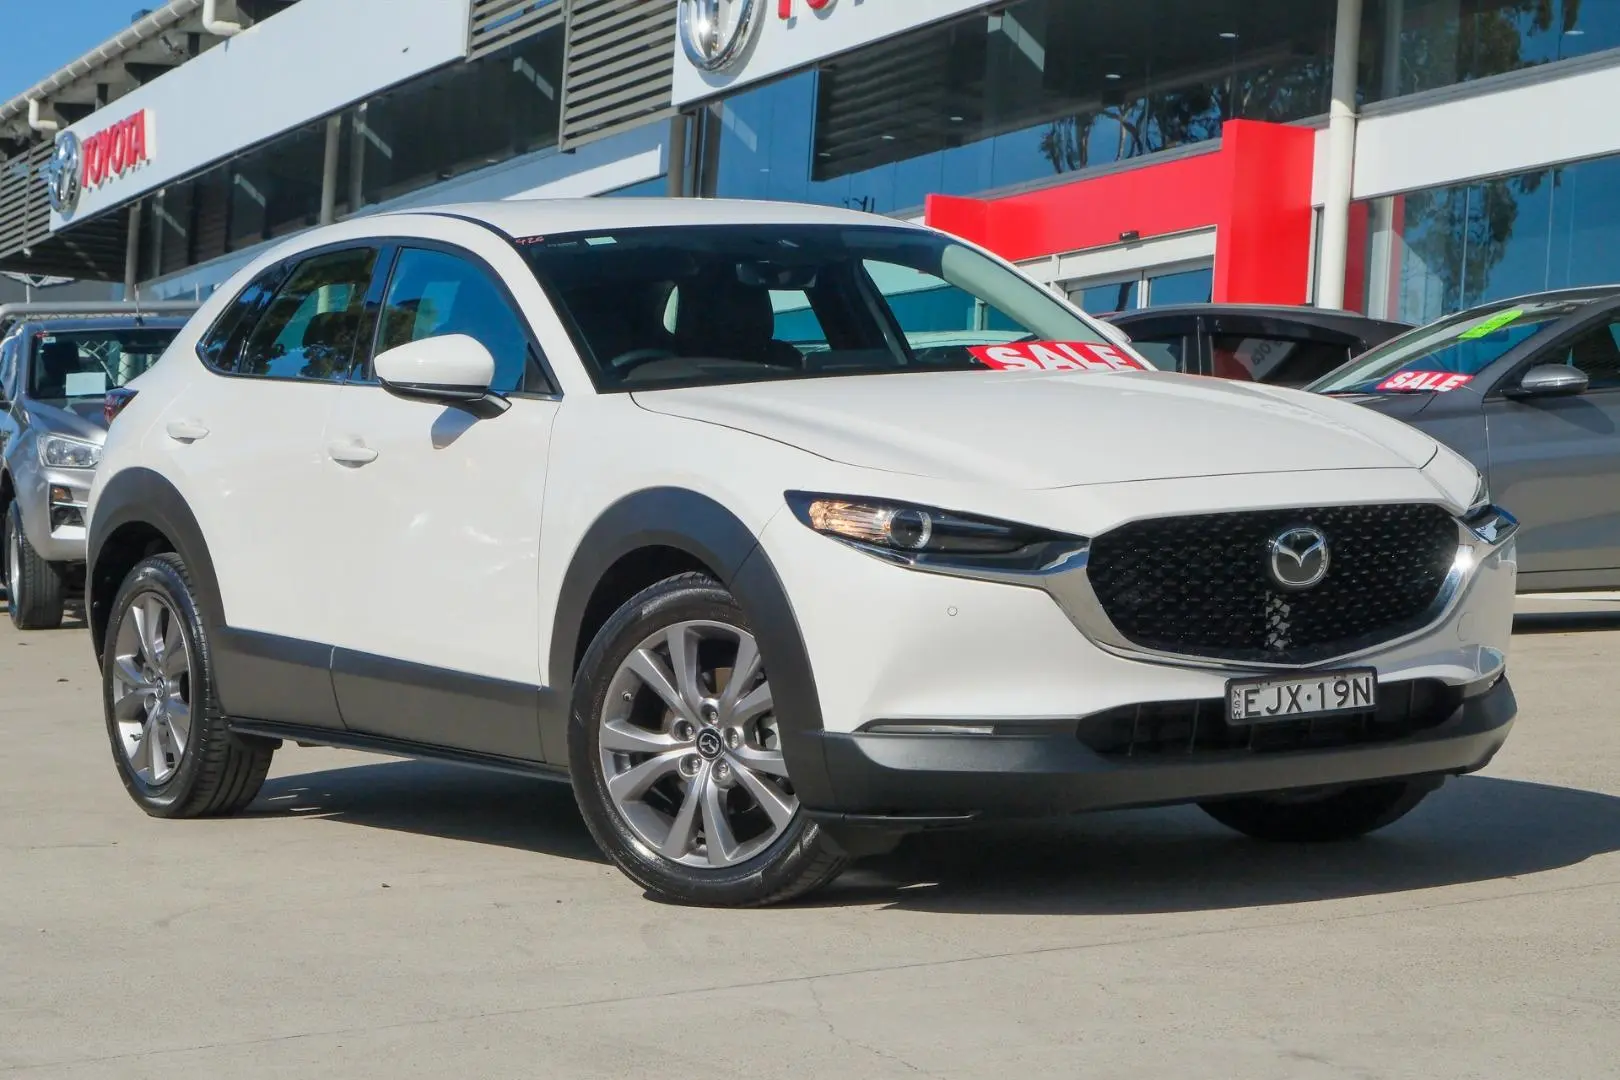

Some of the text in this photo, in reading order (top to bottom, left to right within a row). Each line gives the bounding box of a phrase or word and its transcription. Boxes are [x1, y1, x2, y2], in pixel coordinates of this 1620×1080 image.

[80, 108, 146, 188] TOYOTA
[986, 343, 1138, 372] SALE
[1384, 371, 1468, 393] SALE
